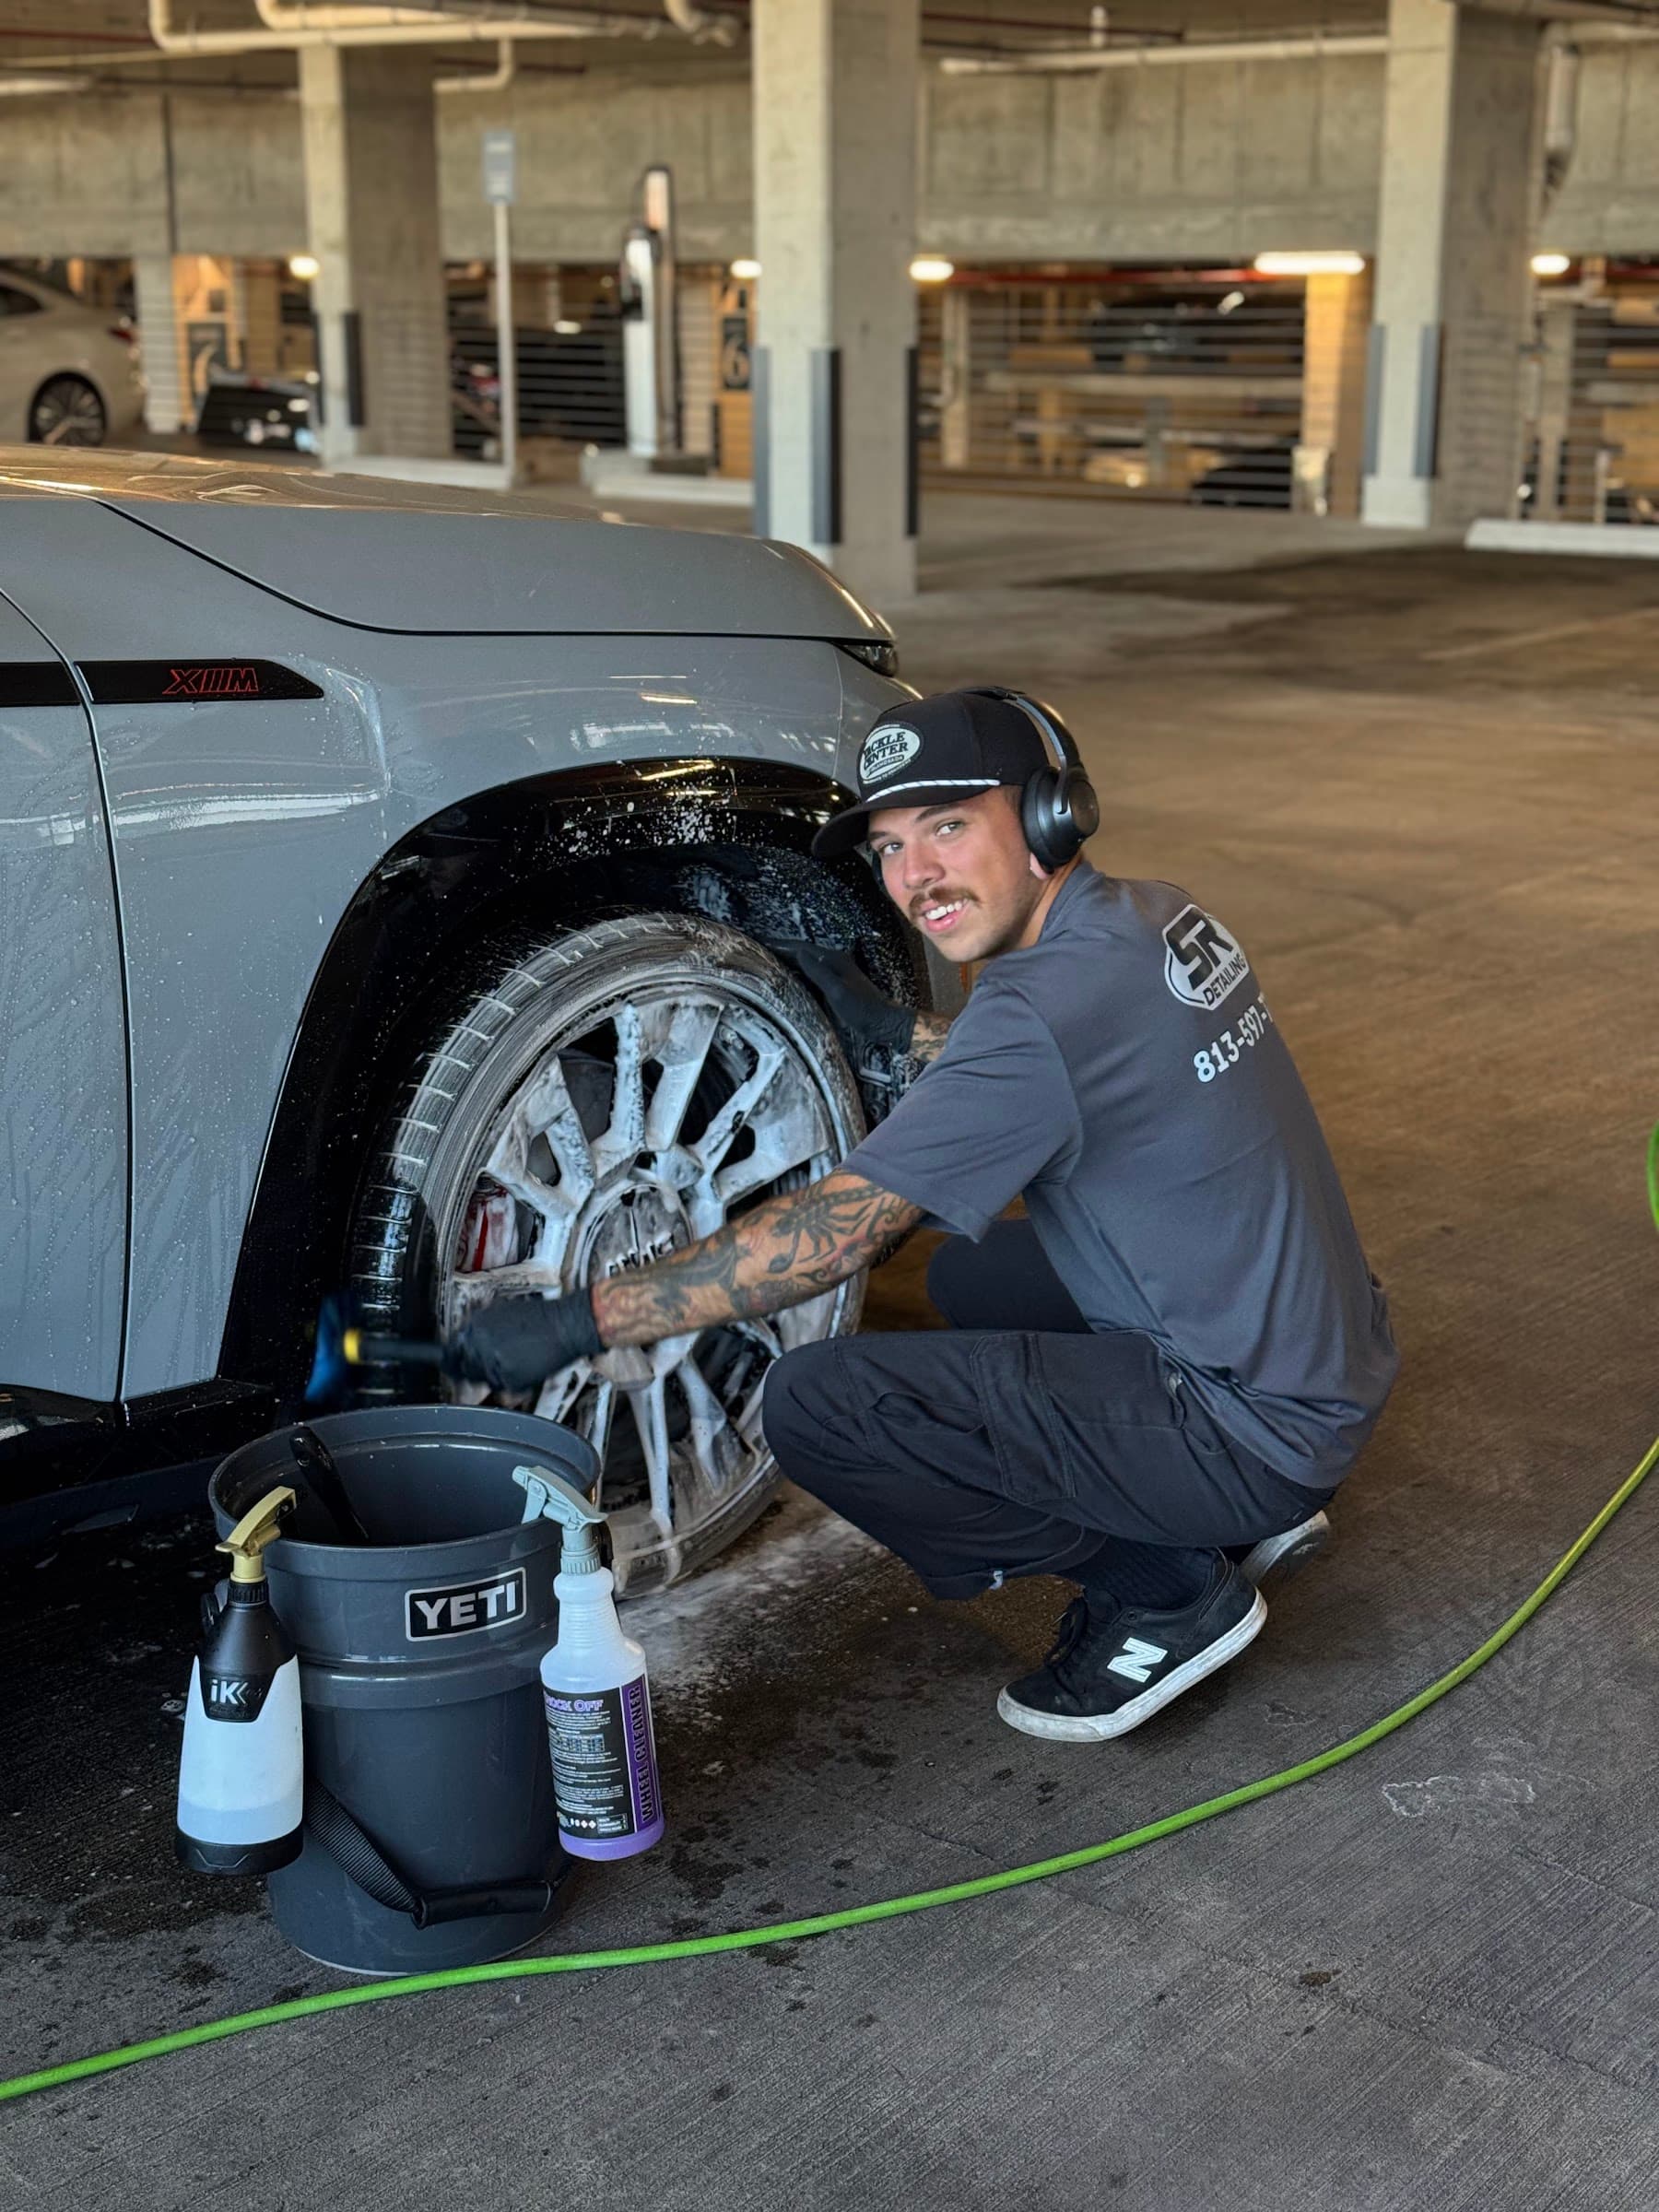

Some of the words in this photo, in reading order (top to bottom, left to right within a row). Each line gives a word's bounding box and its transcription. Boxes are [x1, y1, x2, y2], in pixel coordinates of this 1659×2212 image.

[865, 732, 906, 757] ACKLE
[1166, 907, 1233, 991] SR
[1203, 953, 1246, 1006] DETAILING
[415, 1581, 516, 1630] YETI
[1107, 1637, 1168, 1683] N
[543, 1694, 572, 1712] OCK
[573, 1699, 604, 1712] OFF
[629, 1684, 648, 1763] CLEANER
[636, 1764, 655, 1824] WHEEL
